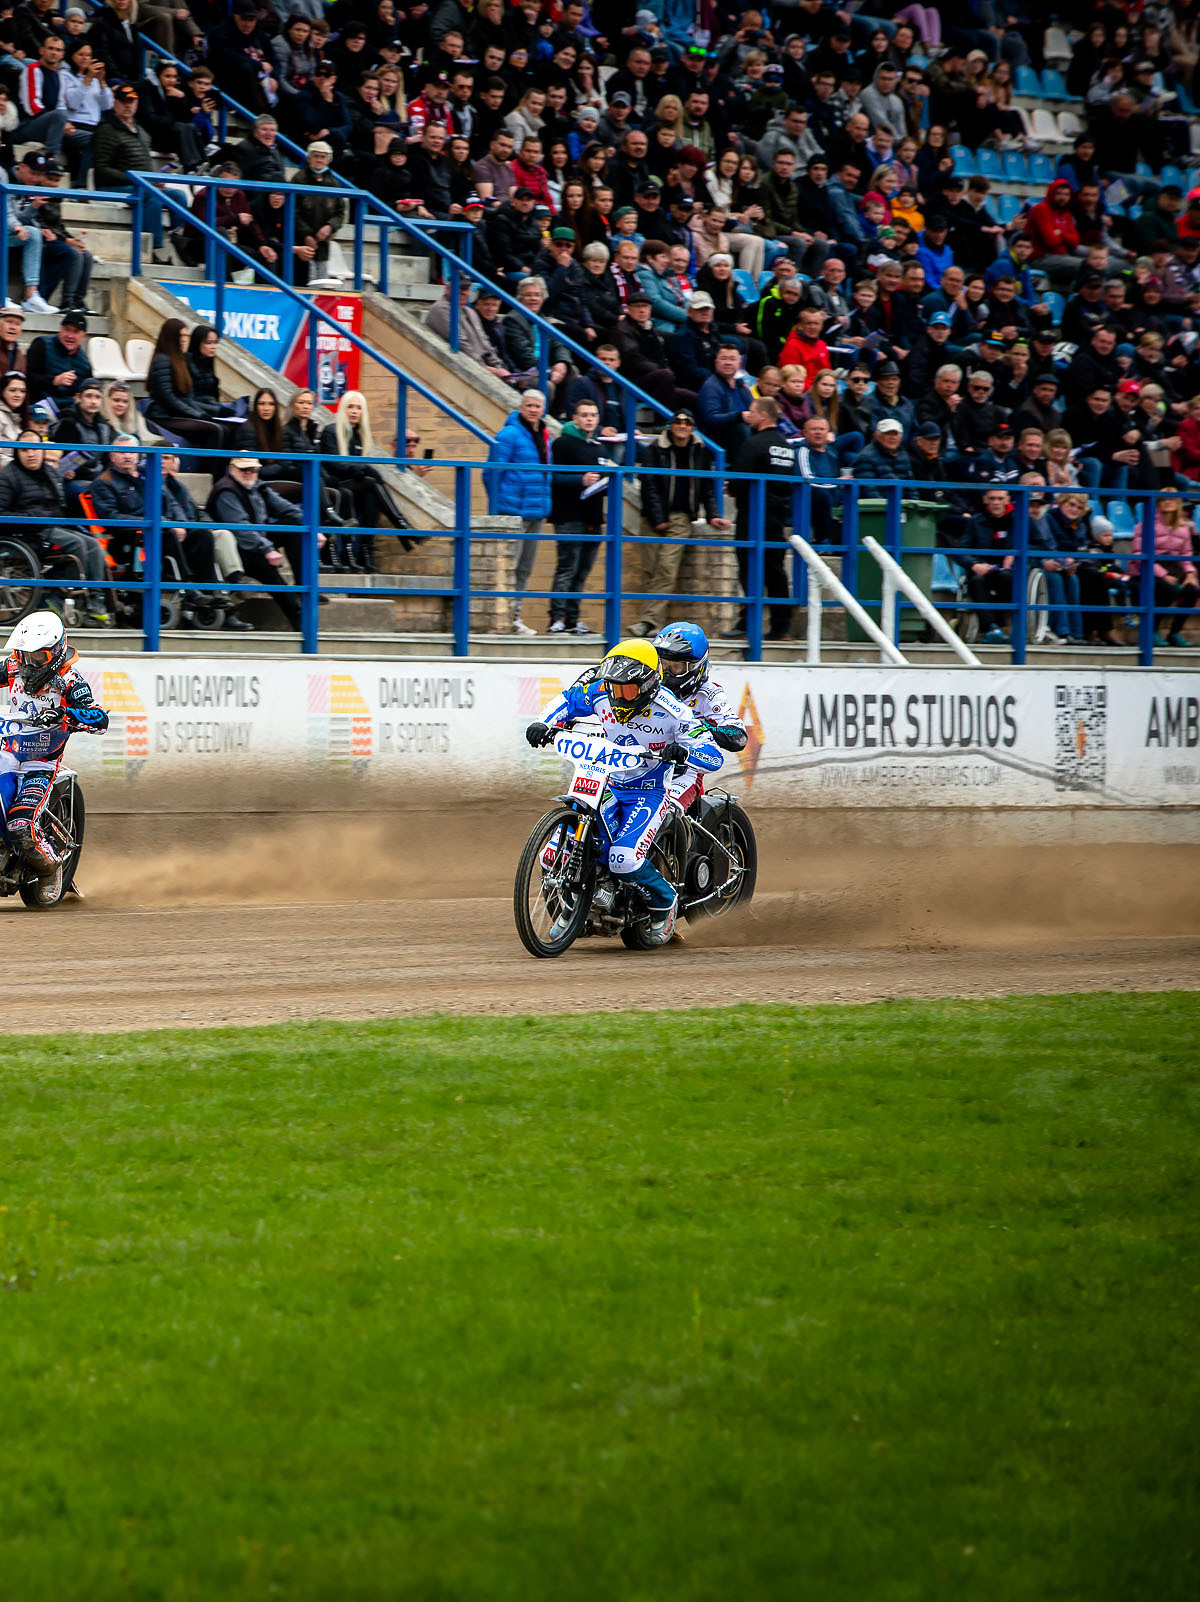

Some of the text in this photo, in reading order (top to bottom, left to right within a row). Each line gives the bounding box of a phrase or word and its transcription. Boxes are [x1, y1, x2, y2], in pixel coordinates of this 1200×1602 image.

[155, 675, 261, 707] DAUGAVPILS
[379, 677, 475, 708] DAUGAVPILS
[798, 693, 1017, 747] AMBER STUDIOS
[1144, 696, 1200, 747] AMB
[155, 721, 253, 753] IS SPEEDWAY
[397, 722, 450, 753] SPORTS
[575, 778, 599, 790] AMD
[578, 763, 607, 774] NEXORIS
[573, 786, 598, 795] GROUP
